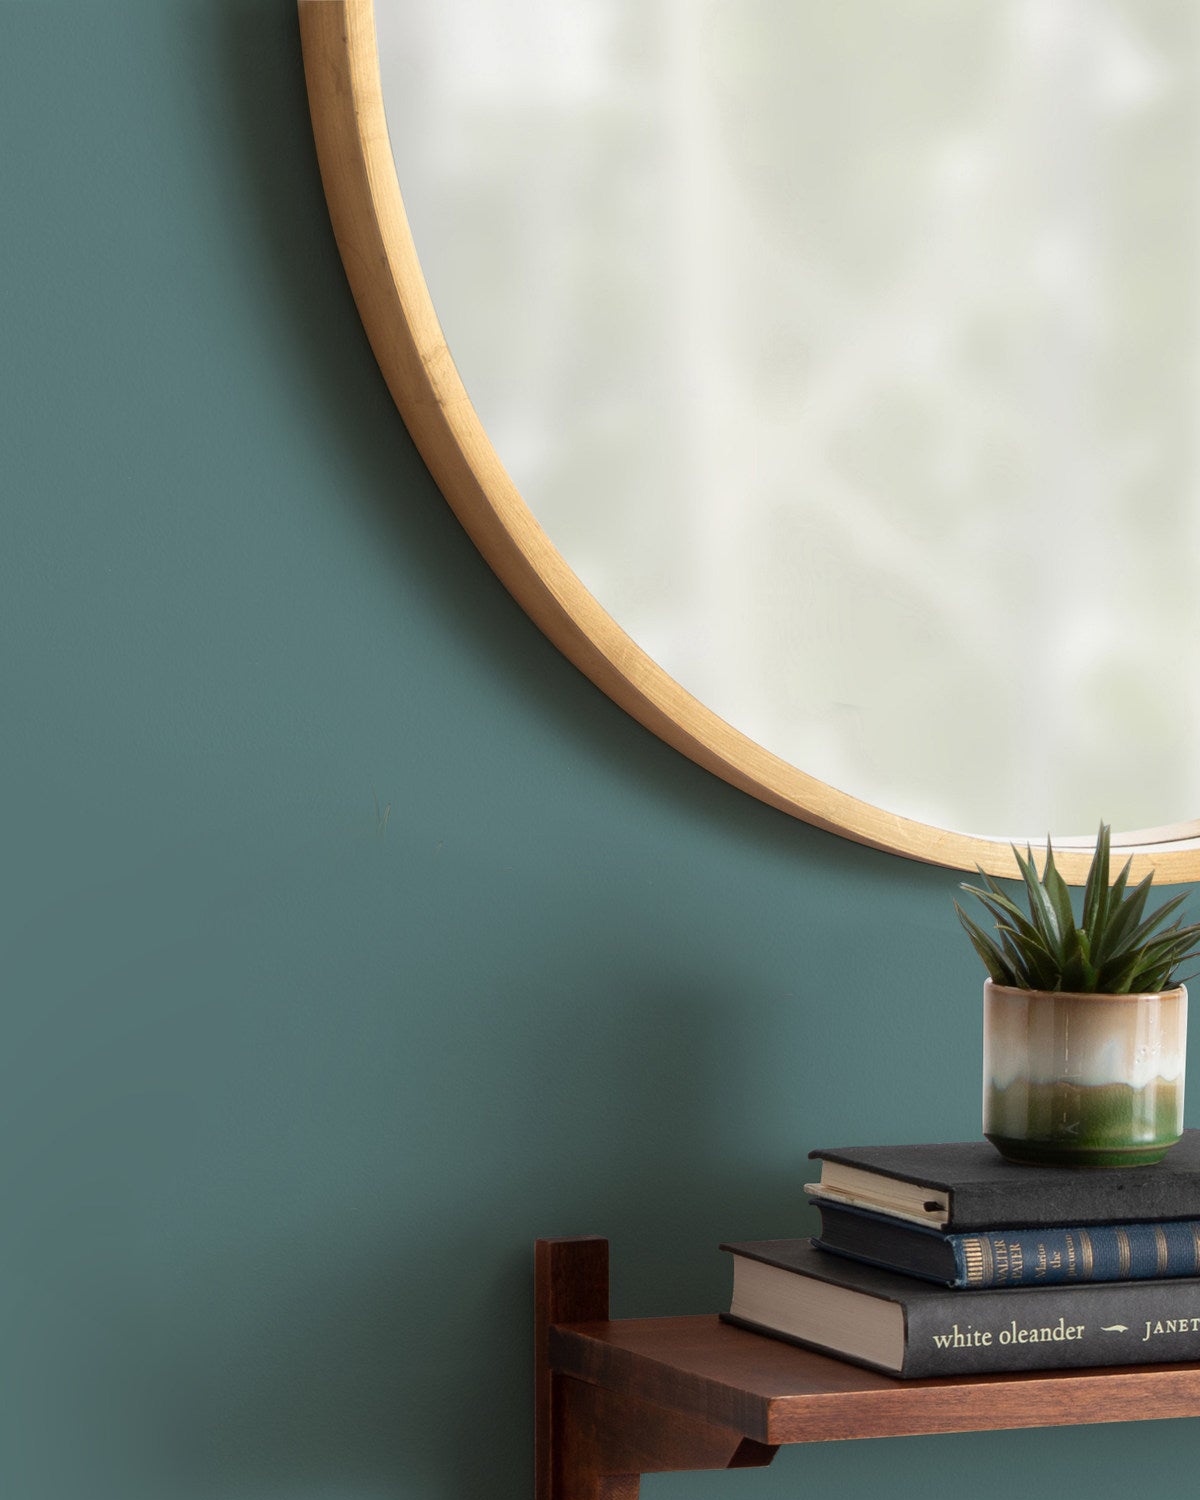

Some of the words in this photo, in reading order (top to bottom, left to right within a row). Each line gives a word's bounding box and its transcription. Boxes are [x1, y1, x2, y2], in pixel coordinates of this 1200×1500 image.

[1009, 1243, 1023, 1279] PATER
[1049, 1251, 1062, 1269] the
[932, 1324, 993, 1349] white
[999, 1317, 1085, 1345] oleander
[1142, 1317, 1200, 1341] JANET
